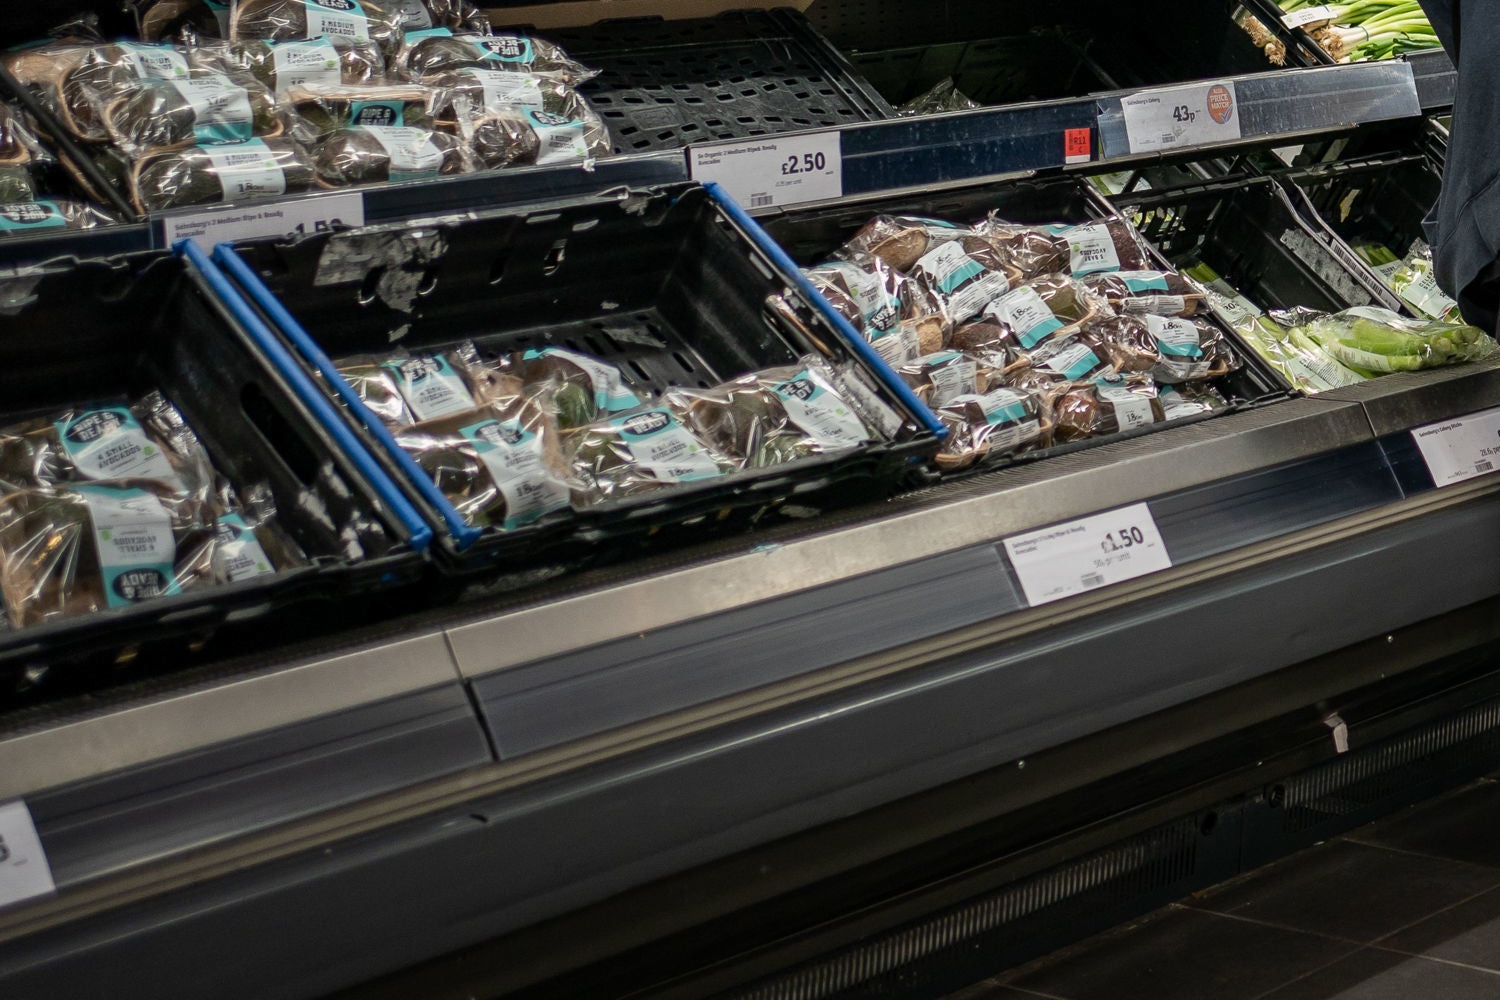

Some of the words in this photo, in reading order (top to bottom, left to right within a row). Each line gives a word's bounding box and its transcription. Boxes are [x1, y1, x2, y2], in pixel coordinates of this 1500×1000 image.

[318, 0, 351, 10] READY
[327, 20, 355, 29] MEDIUM
[321, 26, 356, 36] AVOCADOS
[1127, 98, 1148, 106] Sainsbury's
[1210, 93, 1229, 102] PRICE
[1211, 102, 1229, 110] MATCH
[361, 107, 382, 118] RIPE
[1173, 105, 1196, 123] 43p
[1074, 136, 1087, 145] R11
[704, 151, 722, 160] Organic
[782, 152, 825, 175] £2.50
[175, 221, 211, 231] Sainsbury's
[217, 216, 241, 225] Medium
[243, 214, 257, 222] Ripe
[264, 210, 284, 218] Ready
[1012, 307, 1025, 320] 18
[1162, 321, 1174, 331] 18
[73, 416, 101, 432] RIPE
[1126, 413, 1136, 423] 18
[635, 416, 670, 435] READY
[1419, 427, 1440, 438] Sainsbury's
[1440, 424, 1451, 434] Celery
[106, 440, 134, 458] SMALL
[98, 445, 141, 469] AVOCADOS
[1101, 526, 1144, 554] £1.50
[121, 573, 159, 587] READY
